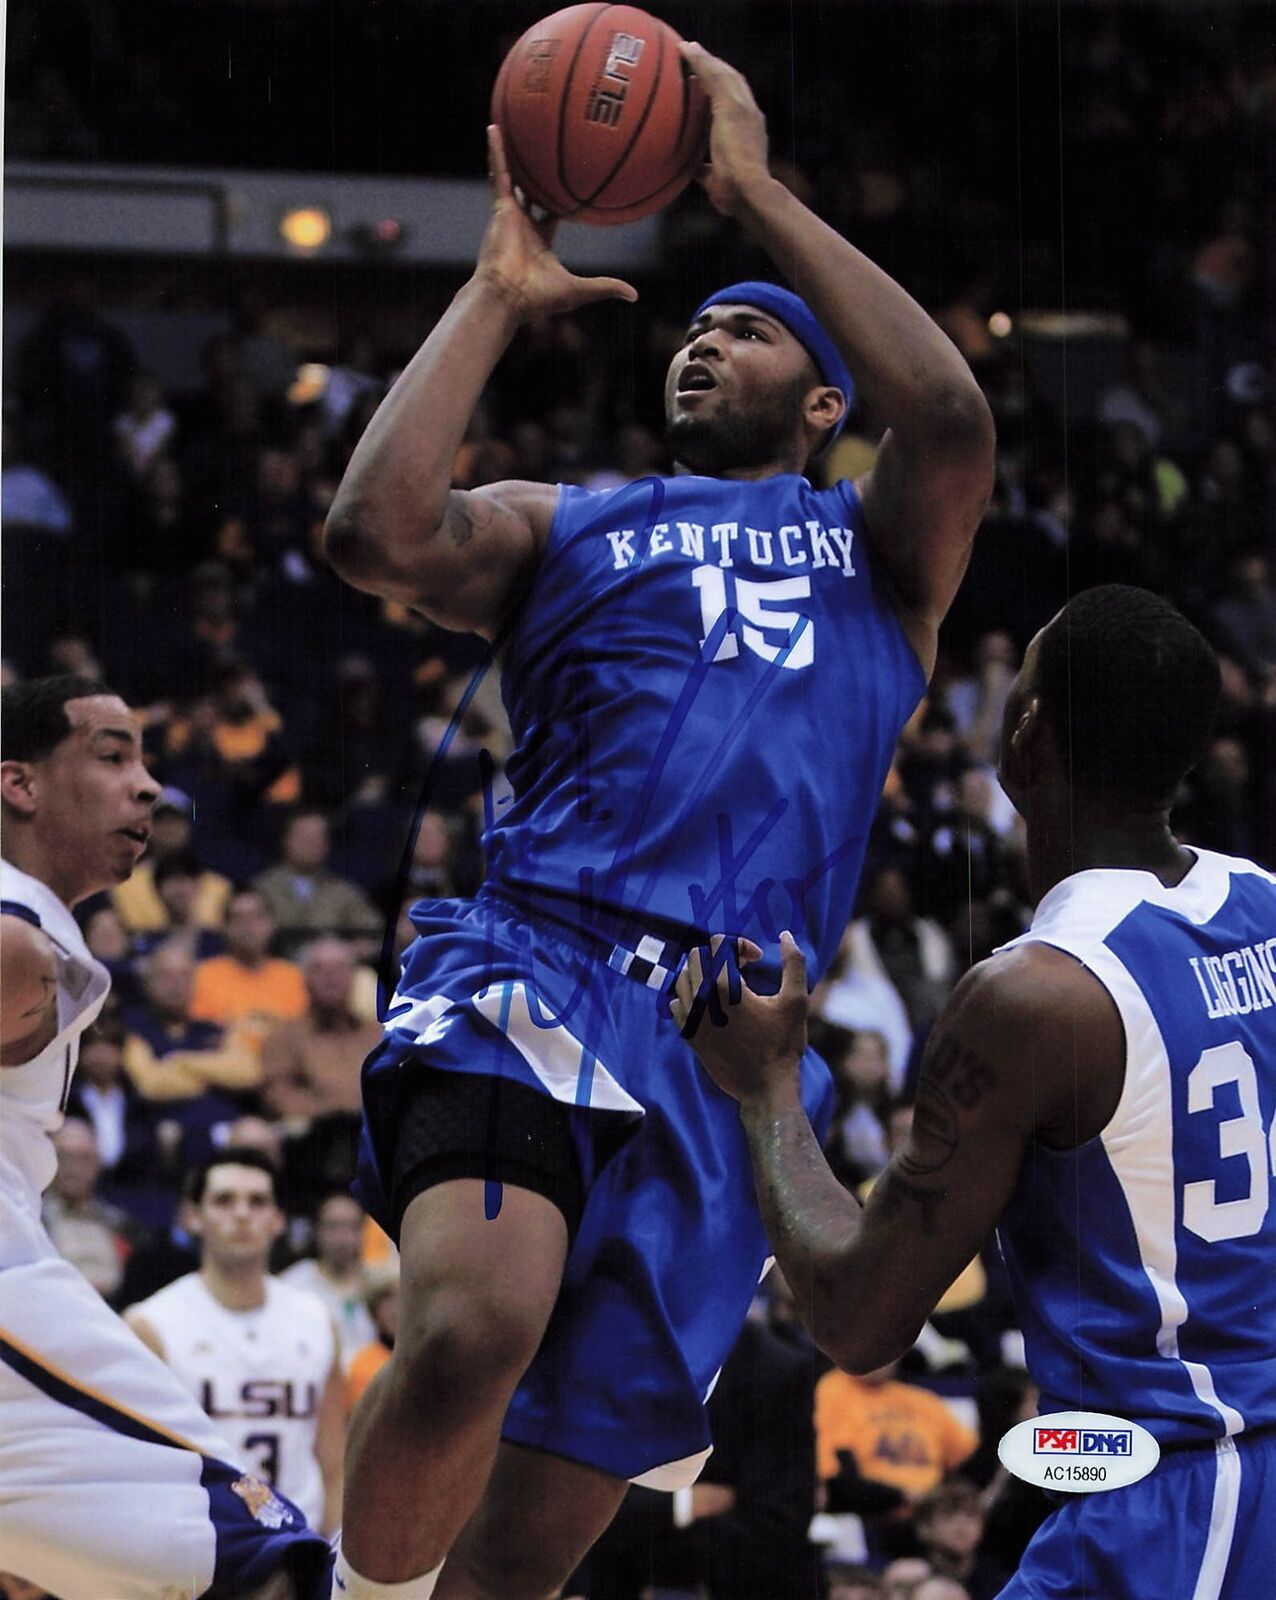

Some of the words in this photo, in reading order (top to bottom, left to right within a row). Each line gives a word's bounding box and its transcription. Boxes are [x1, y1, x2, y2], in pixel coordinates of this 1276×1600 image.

[606, 520, 856, 577] KENTUCKY
[692, 564, 814, 670] 15
[1182, 1040, 1276, 1243] 3
[202, 1379, 317, 1419] LSU
[1038, 1430, 1077, 1450] PSA
[1083, 1433, 1128, 1454] DNA
[1044, 1466, 1107, 1481] AC15890
